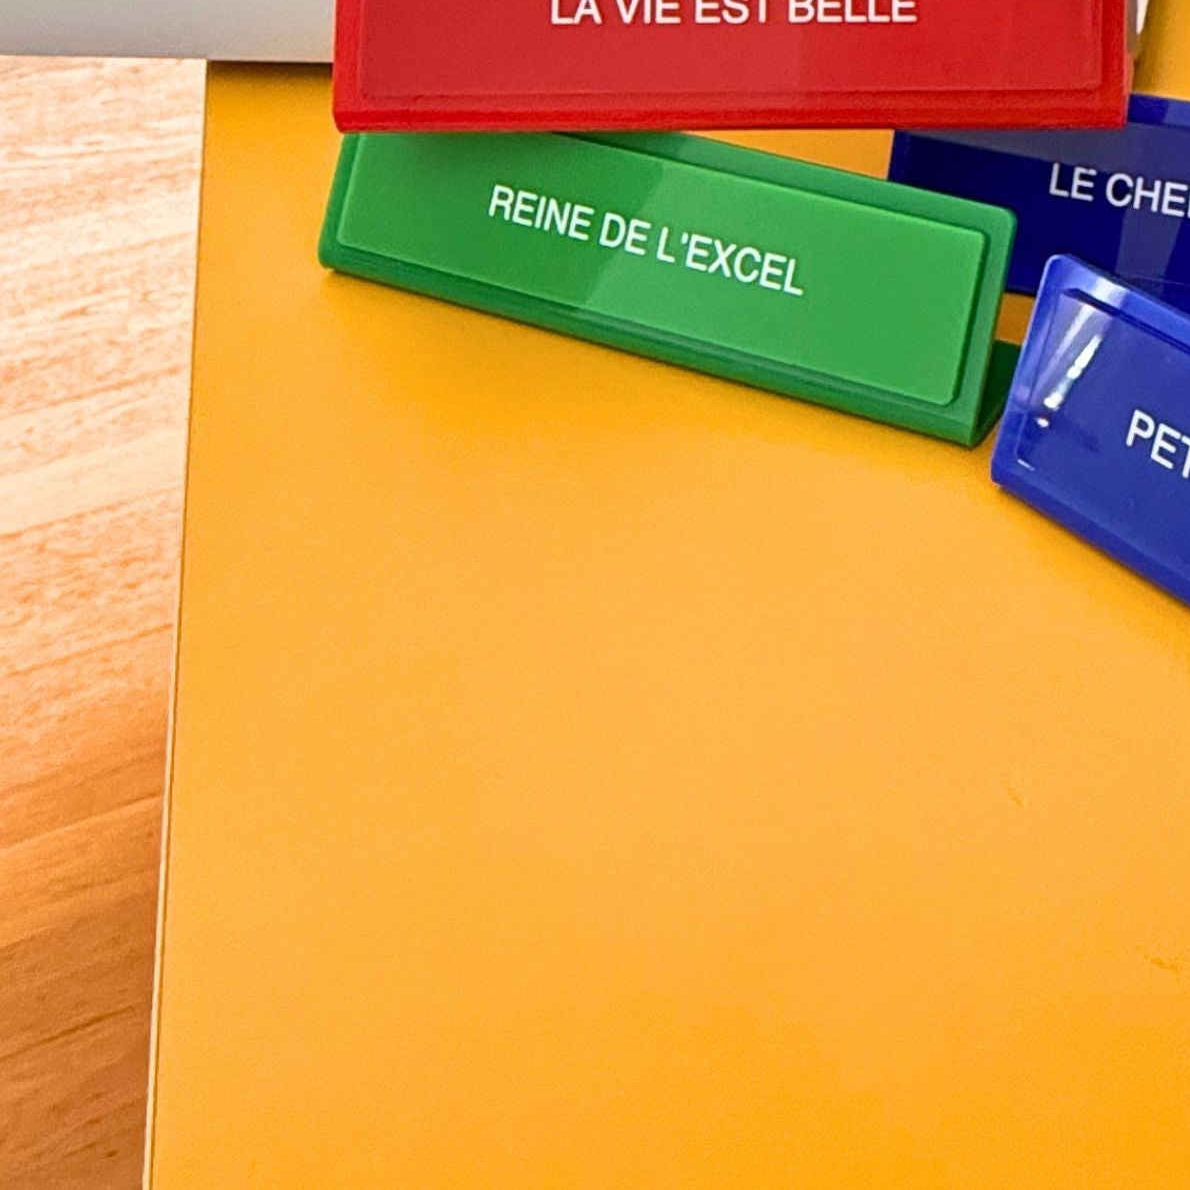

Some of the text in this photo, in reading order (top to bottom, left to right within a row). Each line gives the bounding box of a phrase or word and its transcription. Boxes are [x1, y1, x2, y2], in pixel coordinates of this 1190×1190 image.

[1048, 162, 1097, 202] LE
[488, 184, 804, 296] REINE DE L'EXCEL
